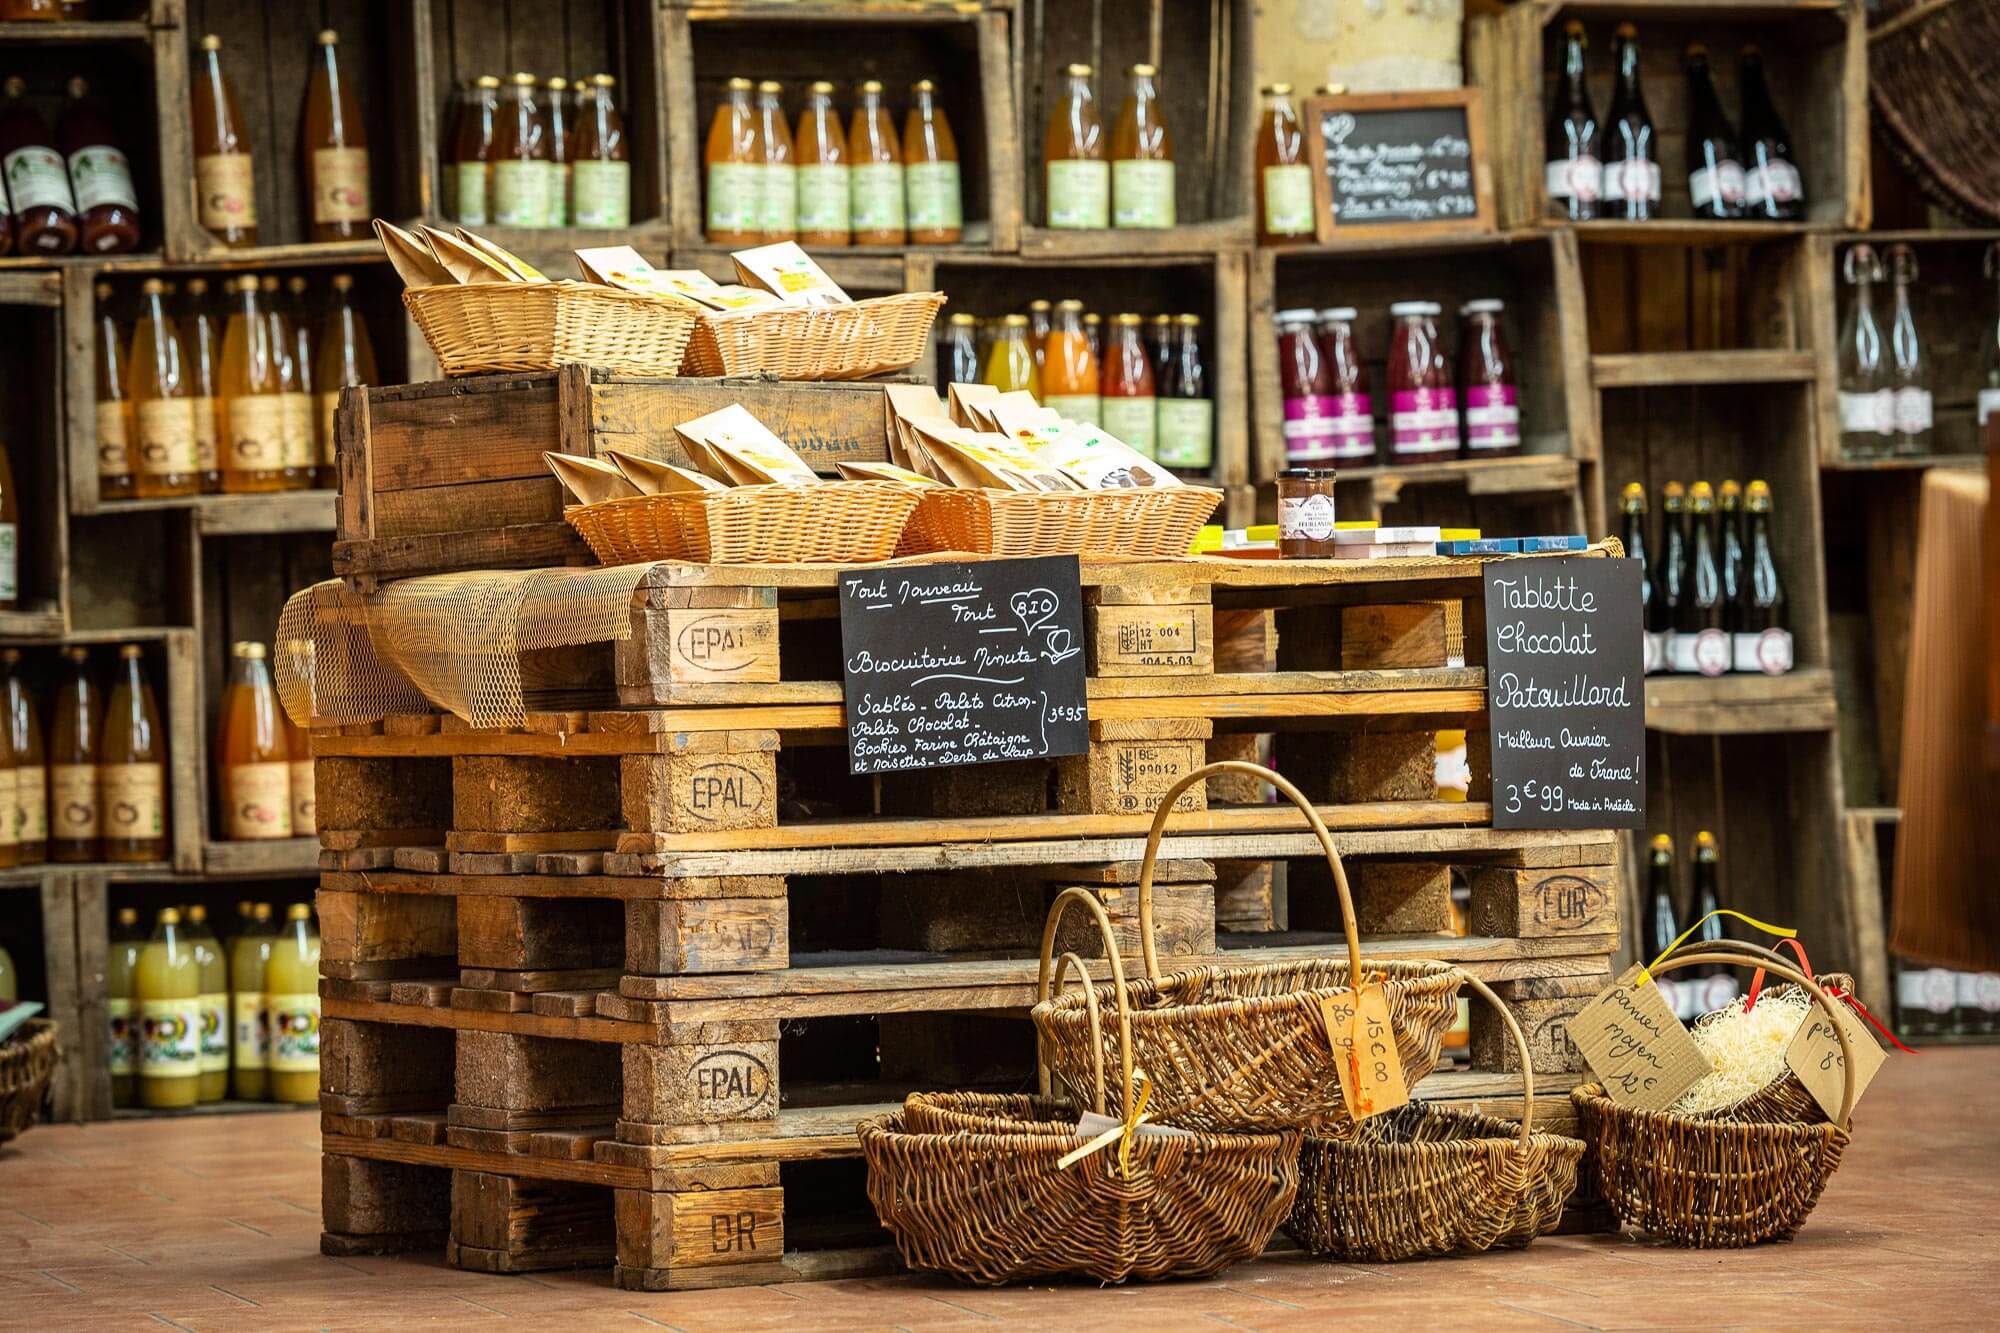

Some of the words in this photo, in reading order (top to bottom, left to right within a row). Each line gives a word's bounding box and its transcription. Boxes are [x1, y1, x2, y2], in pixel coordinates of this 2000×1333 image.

[846, 579, 888, 599] Tout
[1493, 575, 1598, 613] Tablette
[951, 602, 996, 623] Tout
[1016, 598, 1053, 617] BIO
[1496, 620, 1598, 655] Chocolat
[857, 693, 916, 716] Sablés
[934, 691, 984, 710] Palets
[1495, 672, 1632, 709] Patouillard
[851, 718, 900, 738] Palets
[907, 711, 970, 734] Chocolat
[1047, 704, 1087, 723] 3€95
[914, 735, 958, 752] Farine
[963, 730, 1031, 755] Châtaigne
[1498, 729, 1556, 750] Meilleur
[1560, 725, 1611, 748] Ouvrier
[854, 759, 868, 772] et
[939, 750, 977, 764] Dents
[982, 749, 999, 760] de
[1569, 762, 1586, 778] de
[692, 776, 753, 809] EPAL
[1504, 779, 1564, 814] 3€99
[1591, 797, 1603, 811] in
[1601, 988, 1661, 1039] panier
[1603, 1022, 1664, 1070] moyen
[697, 1066, 760, 1100] EPAL
